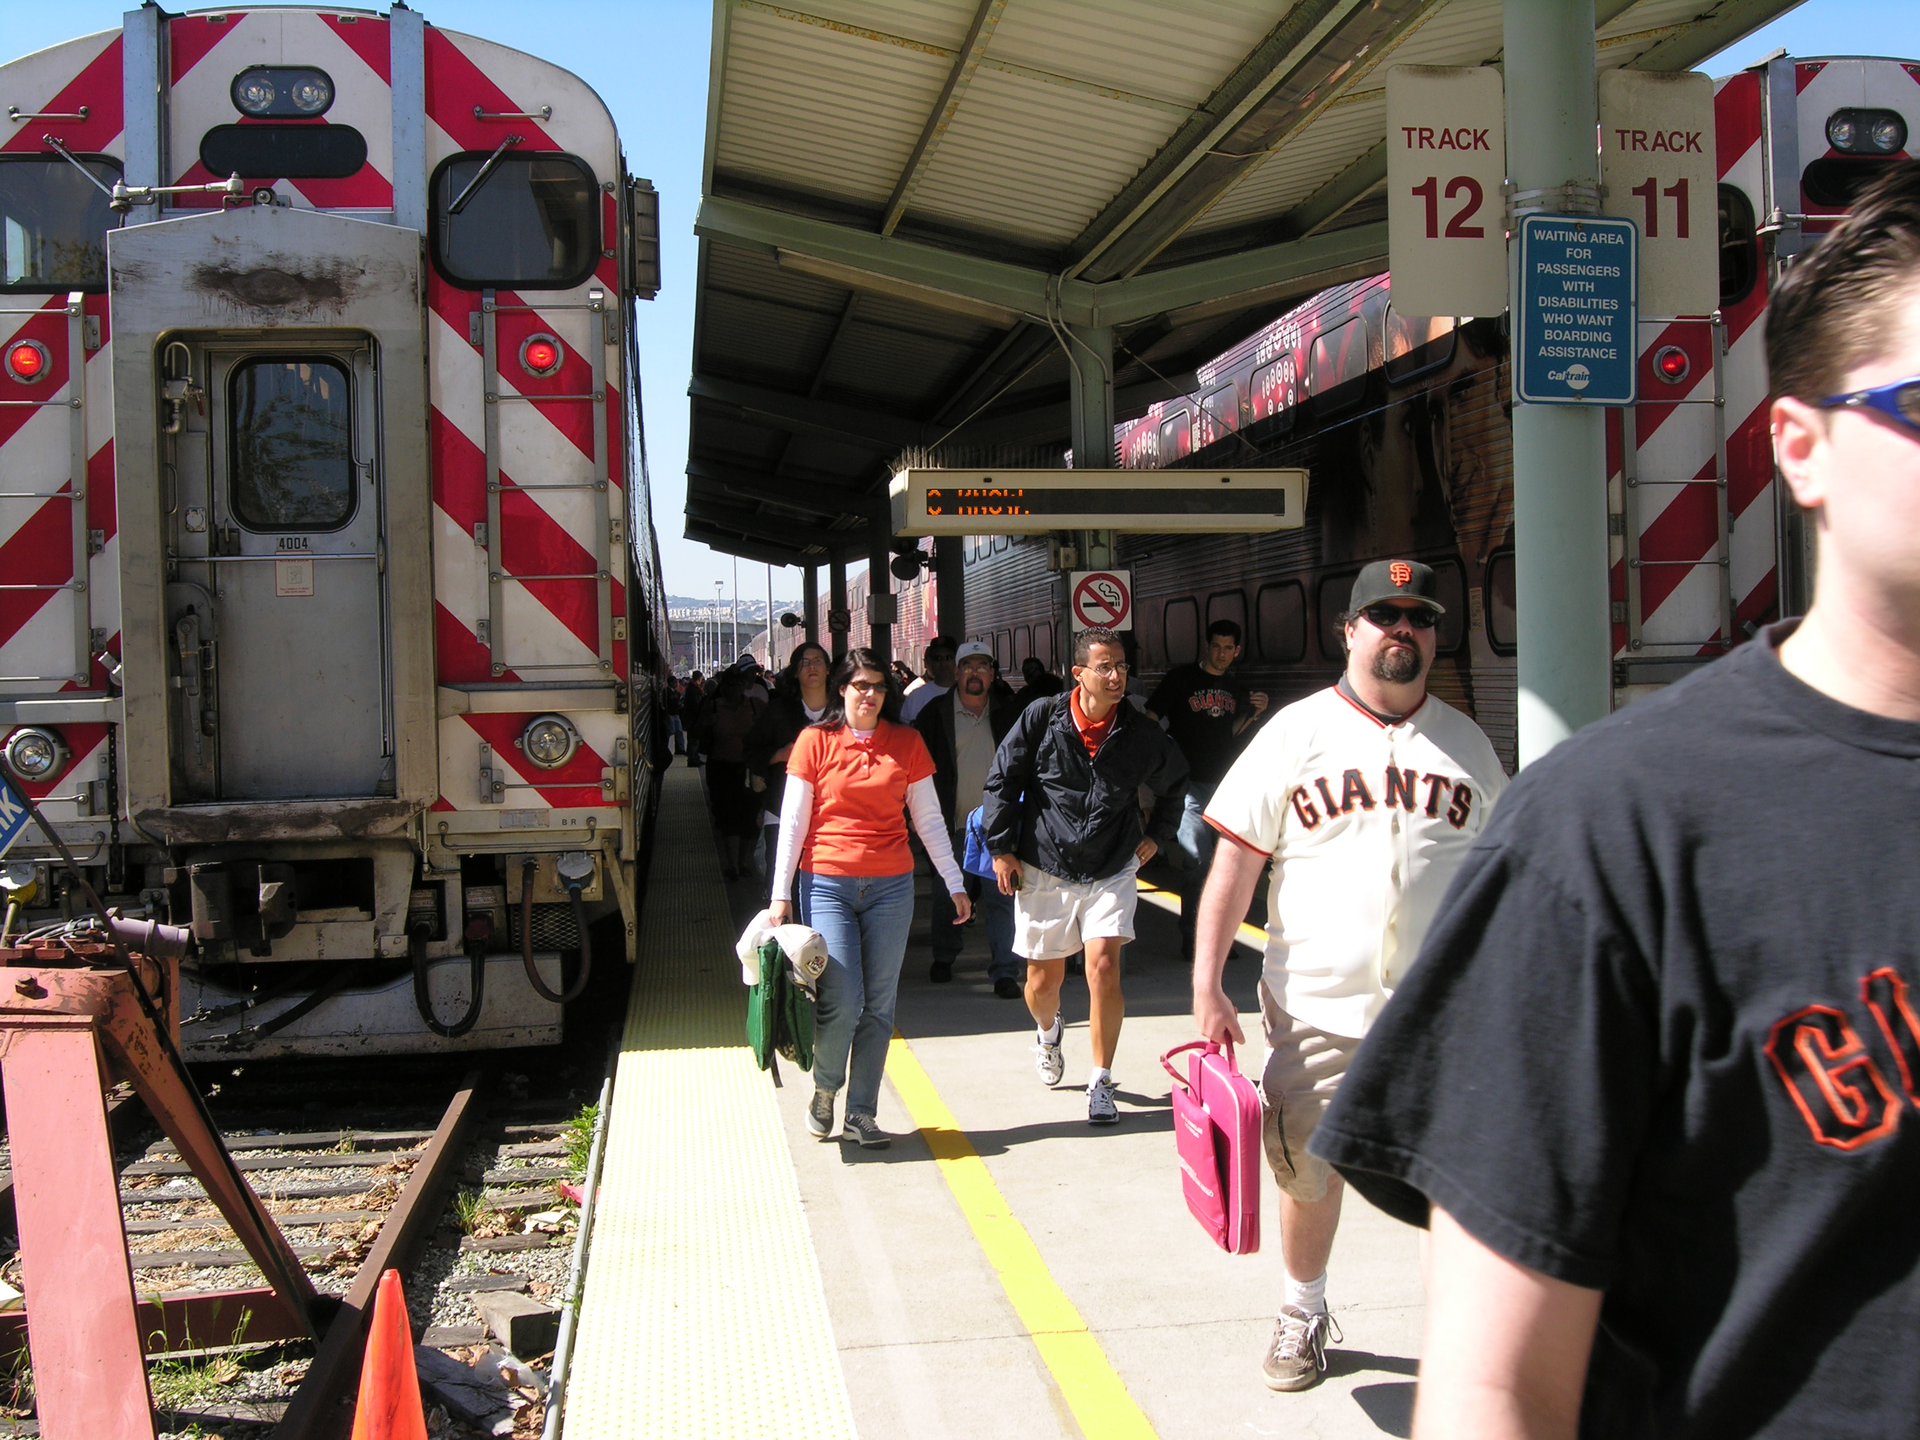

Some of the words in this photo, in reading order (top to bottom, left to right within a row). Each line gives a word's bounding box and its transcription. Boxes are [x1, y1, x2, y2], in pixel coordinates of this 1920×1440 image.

[1401, 127, 1490, 151] TRACK
[1615, 129, 1703, 153] TRACK
[1411, 175, 1485, 239] 12
[1631, 177, 1690, 239] 11
[1534, 229, 1587, 243] WAITING
[1590, 232, 1625, 245] AREA
[1566, 248, 1592, 259] FOR
[1537, 263, 1621, 277] PASSENGERS
[1562, 280, 1595, 293] WITH
[1538, 296, 1619, 310] DISABILITIES
[1542, 312, 1574, 325] WHO
[1576, 314, 1614, 326] WANT
[1544, 329, 1612, 343] BOARDING
[1538, 346, 1617, 359] ASSISTANCE
[1547, 370, 1592, 382] Caltrain
[279, 537, 309, 550] 4004
[1188, 693, 1237, 714] GIANTS
[1291, 765, 1473, 831] GIANTS
